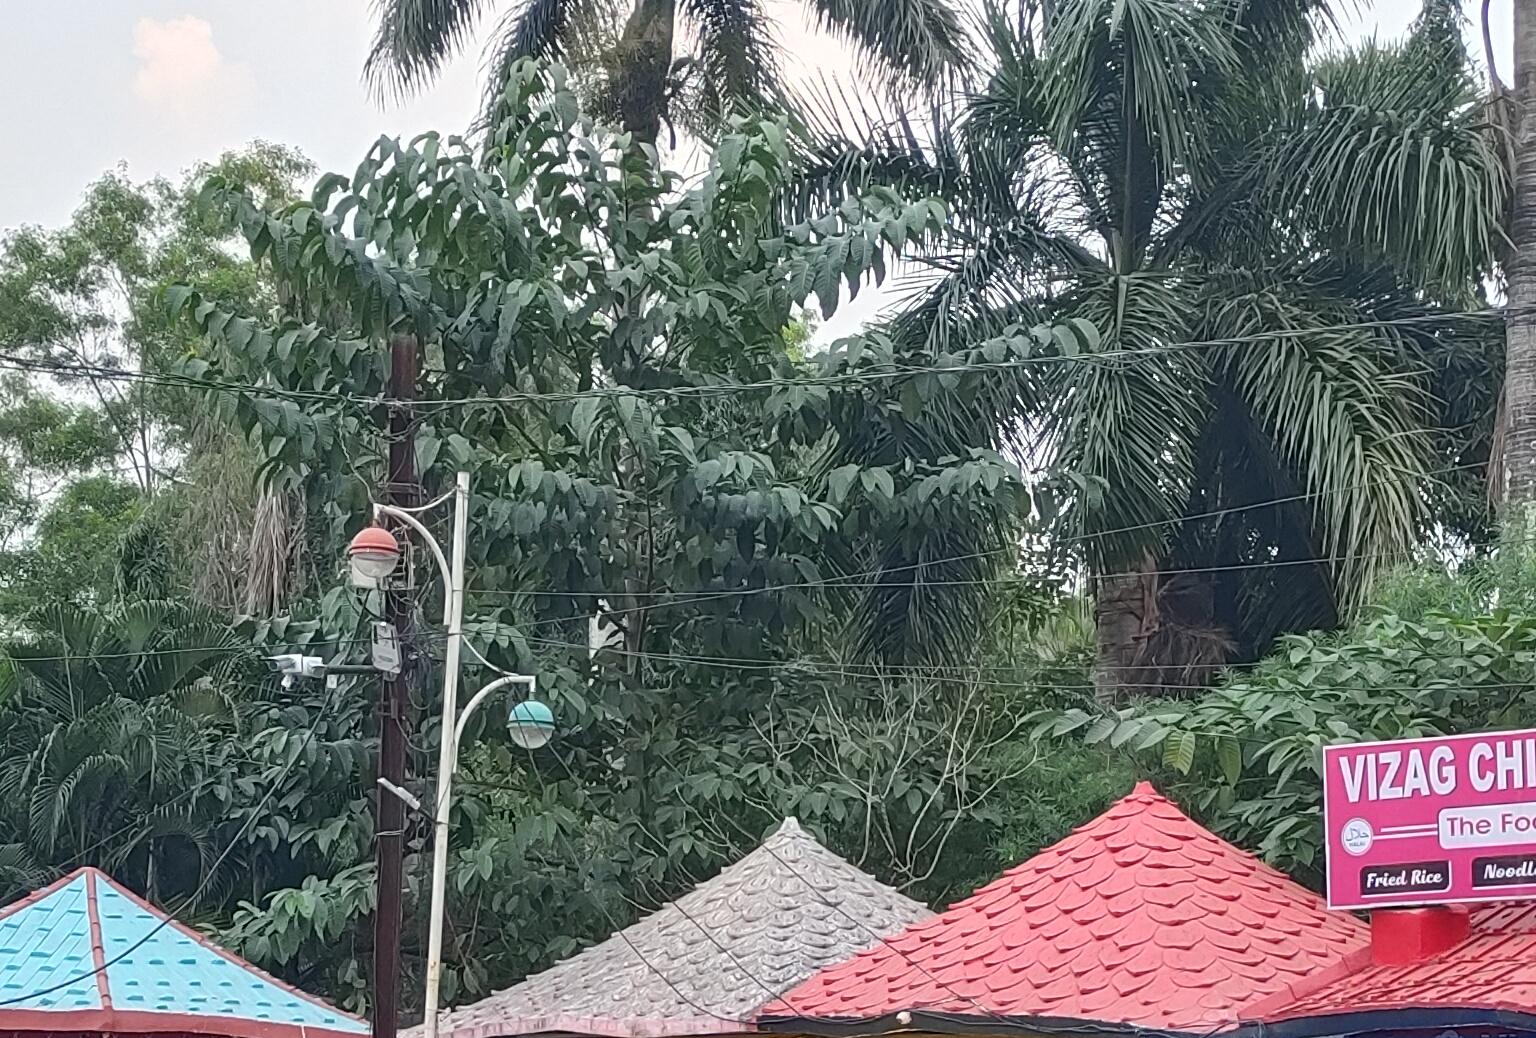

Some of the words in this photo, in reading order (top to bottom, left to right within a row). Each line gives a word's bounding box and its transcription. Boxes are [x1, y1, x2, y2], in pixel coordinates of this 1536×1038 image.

[1338, 749, 1457, 803] VIZAG
[1447, 815, 1491, 837] The
[1367, 871, 1406, 889] Fried
[1411, 869, 1443, 886] Rice
